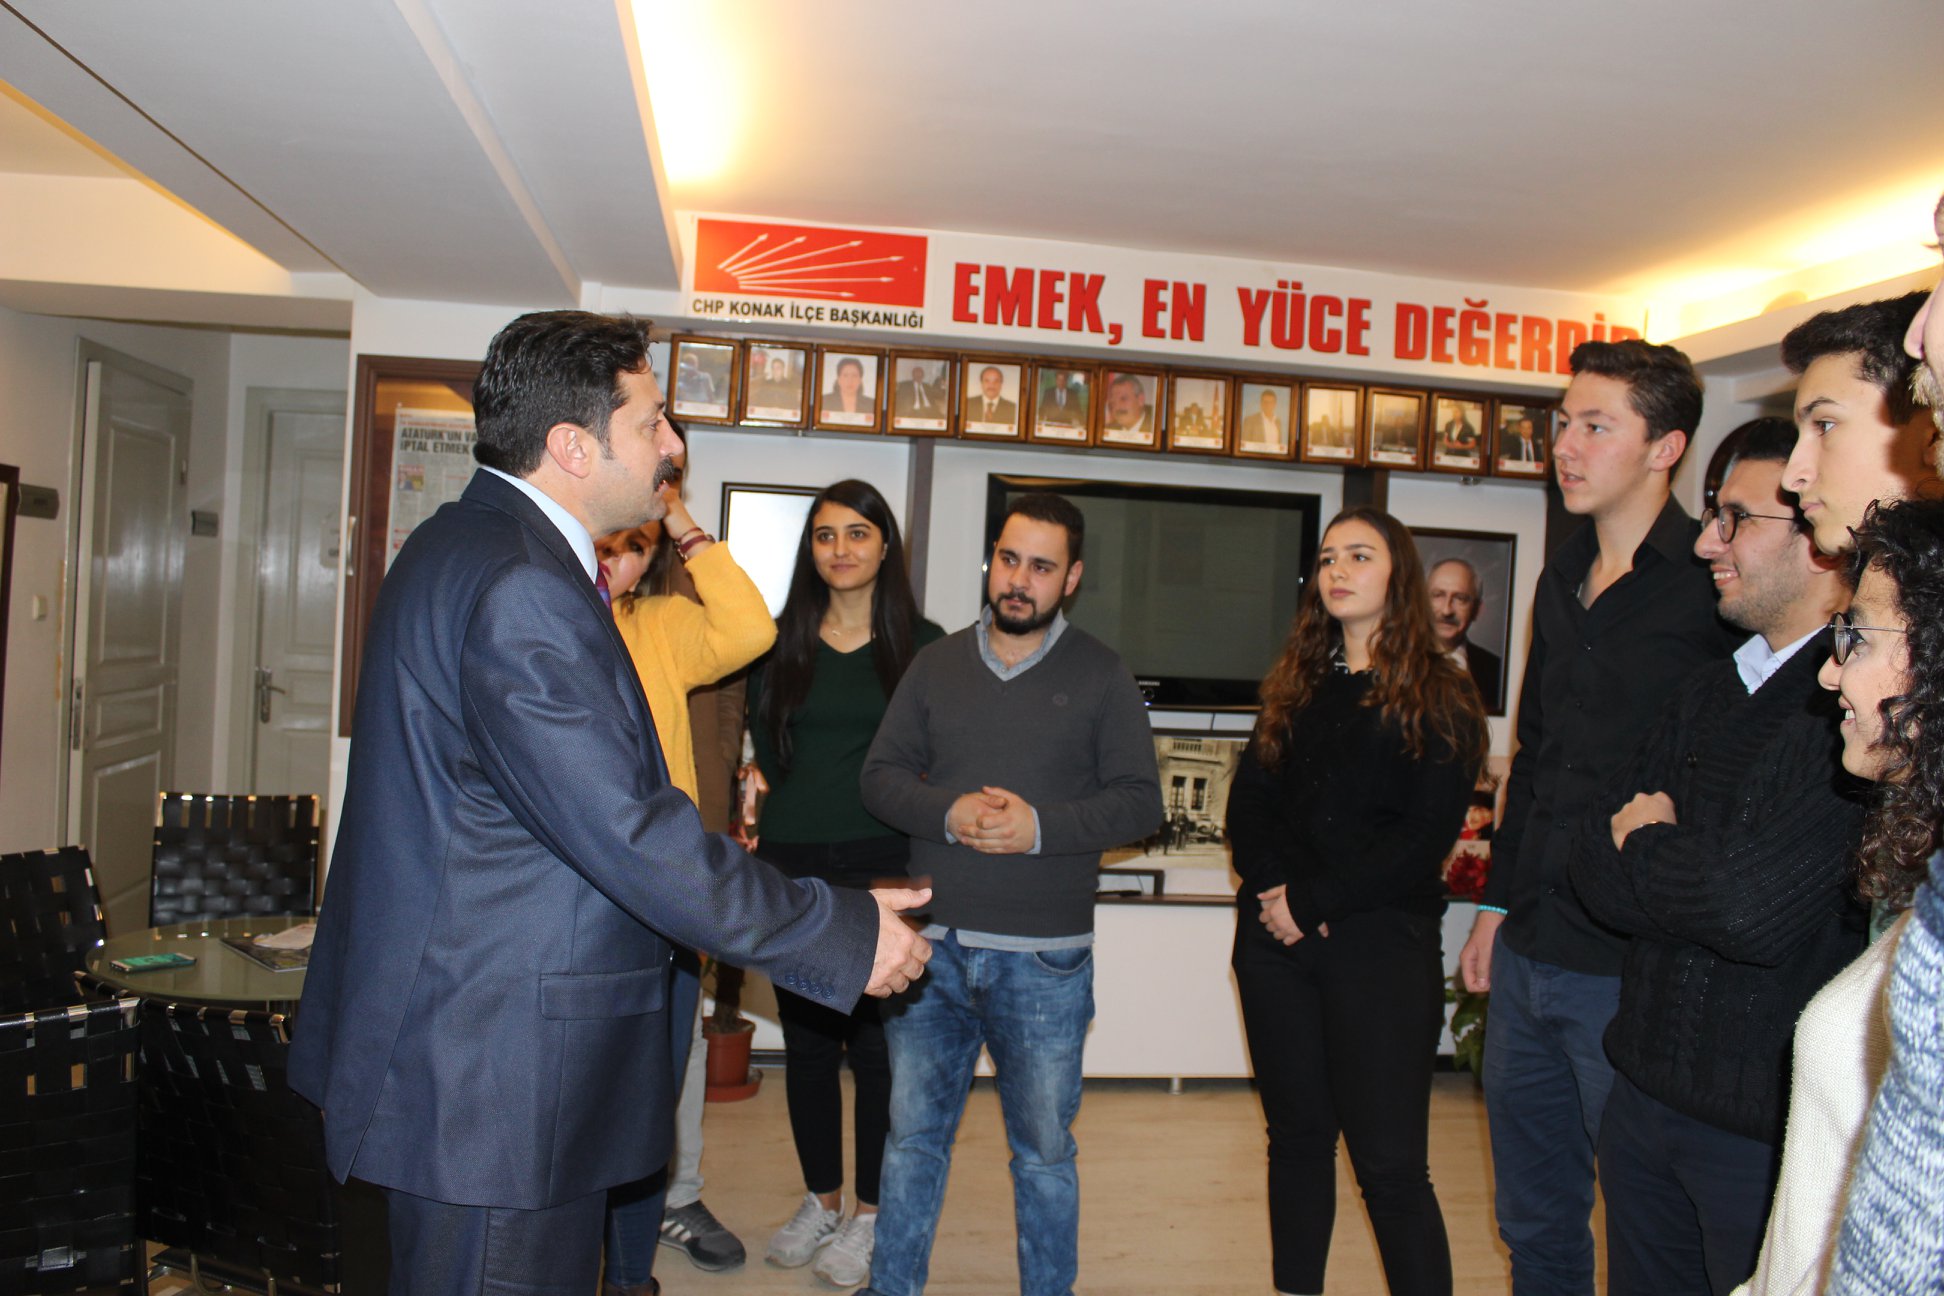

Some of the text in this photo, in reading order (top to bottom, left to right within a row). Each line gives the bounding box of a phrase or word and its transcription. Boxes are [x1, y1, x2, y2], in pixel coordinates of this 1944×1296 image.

[692, 298, 924, 329] CHP KONAK İLÇE BAŞKANLIĞI
[952, 262, 1640, 375] EMEK, EN YÜCE DEĞERD
